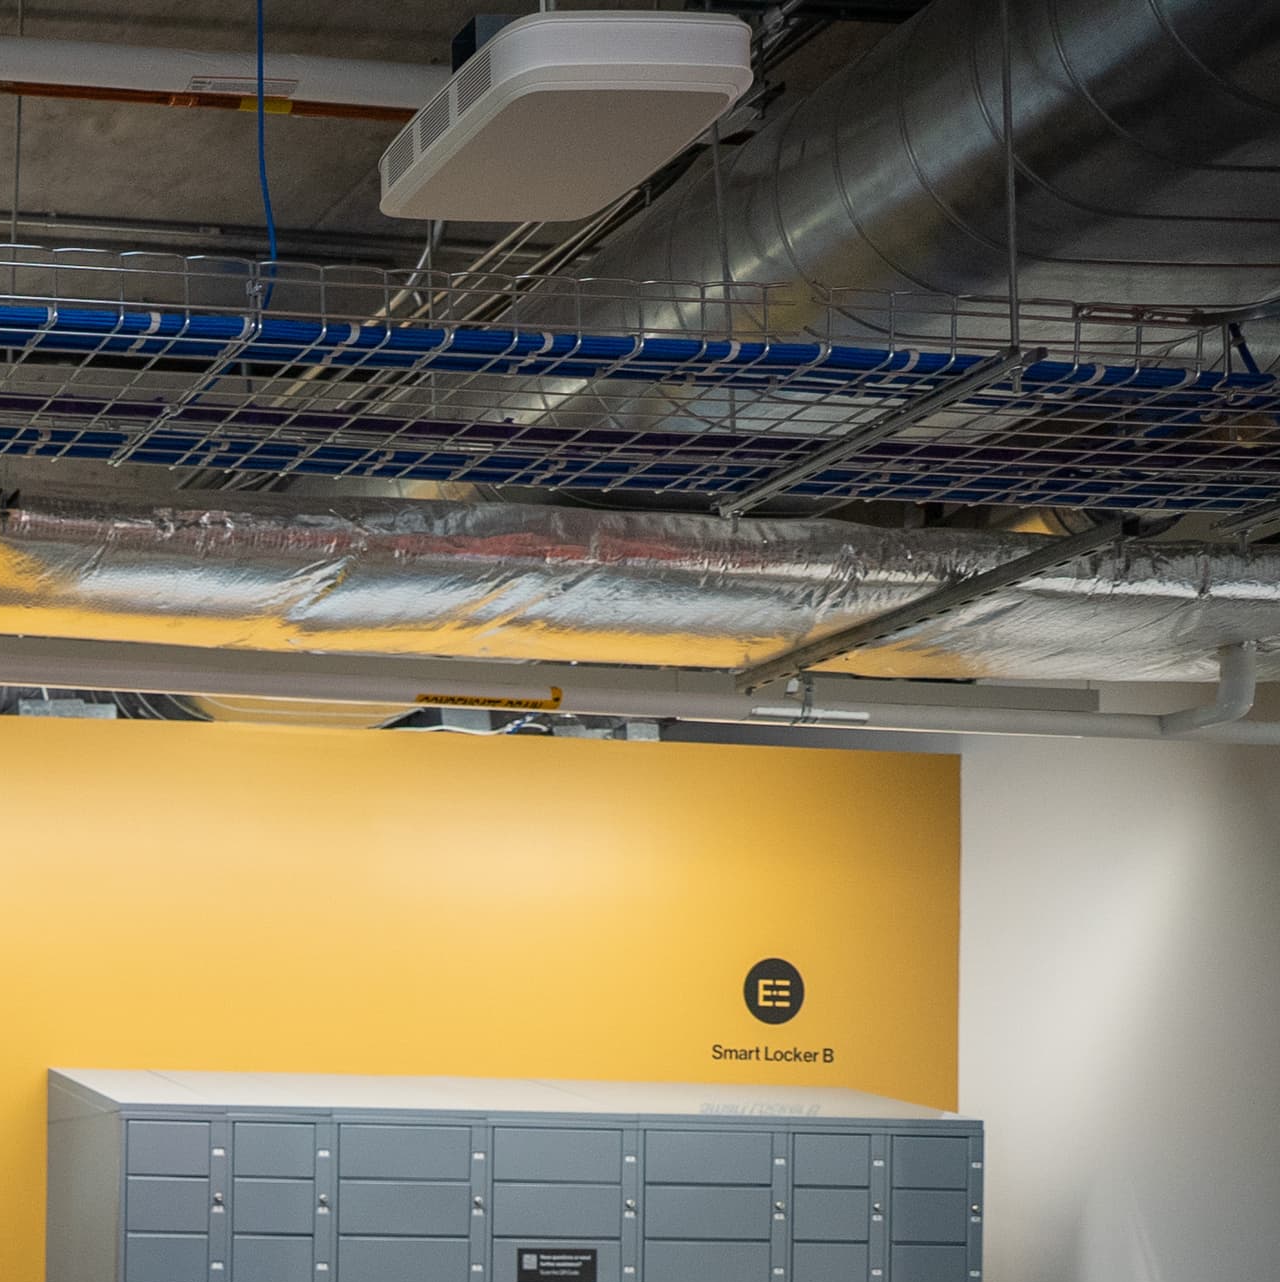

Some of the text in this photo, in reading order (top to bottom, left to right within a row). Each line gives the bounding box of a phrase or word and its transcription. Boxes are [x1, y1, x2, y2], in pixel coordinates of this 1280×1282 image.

[711, 1044, 835, 1063] Smart Locker B
